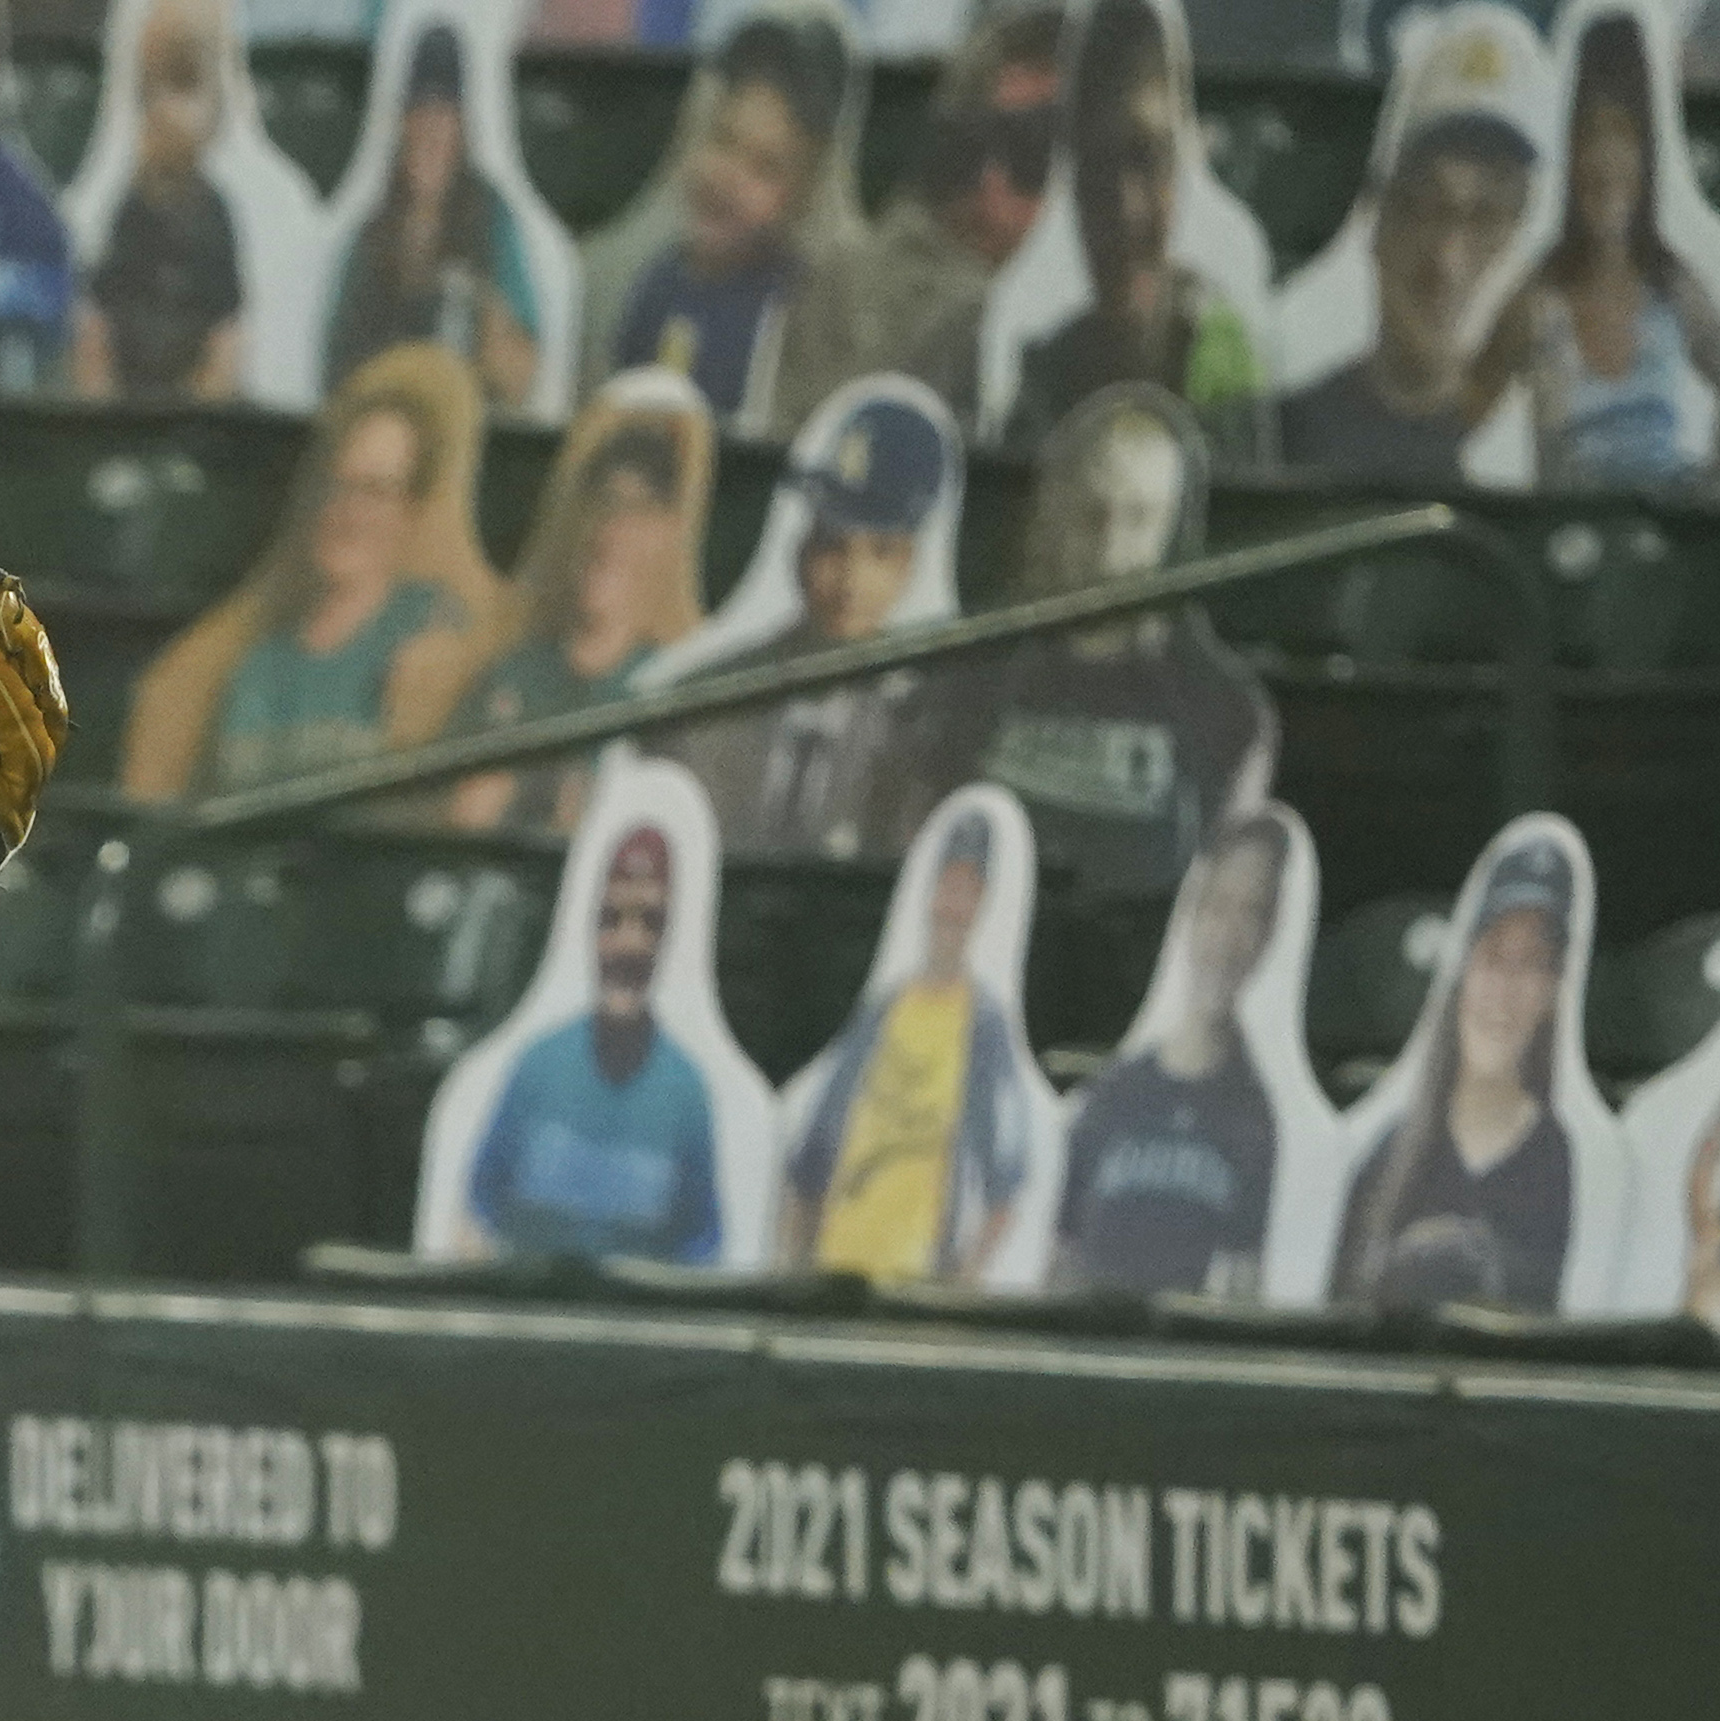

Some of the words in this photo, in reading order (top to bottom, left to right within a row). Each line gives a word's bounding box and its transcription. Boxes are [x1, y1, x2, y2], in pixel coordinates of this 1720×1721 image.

[9, 1414, 313, 1546] DELIVERED
[319, 1431, 398, 1552] TO
[718, 1459, 868, 1598] 2021
[885, 1471, 1151, 1616] SEASON
[1163, 1488, 1441, 1637] TICKETS
[43, 1560, 195, 1682] YOUR
[201, 1568, 361, 1690] DOOR
